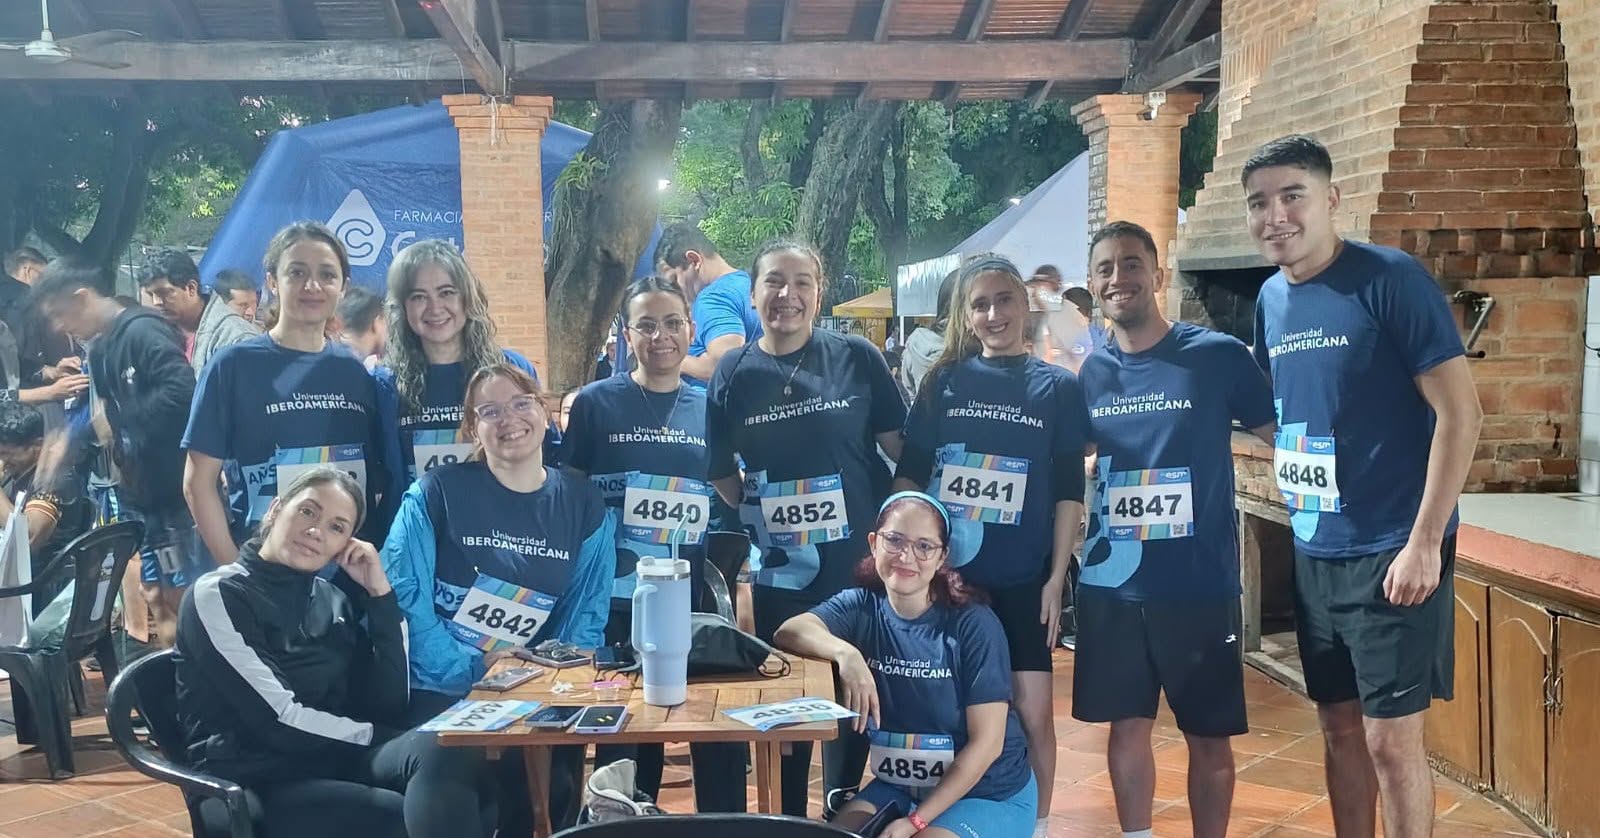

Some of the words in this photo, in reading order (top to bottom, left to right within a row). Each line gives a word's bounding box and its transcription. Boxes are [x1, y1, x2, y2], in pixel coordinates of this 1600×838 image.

[1281, 327, 1323, 343] Universidad
[293, 392, 345, 401] Universidad
[769, 395, 822, 413] Universidad
[1112, 391, 1165, 405] Universidad
[422, 404, 464, 415] Universi
[744, 400, 850, 426] IBEROAMERICANA
[968, 400, 1021, 414] Universidad
[1091, 400, 1192, 418] IBEROAMERICANA
[947, 408, 1044, 429] IBEROAMERICANA
[633, 425, 686, 436] Univerdad
[608, 433, 707, 448] IBEROAMERICANA
[1279, 461, 1328, 488] 4848
[947, 476, 1014, 503] 4841
[632, 498, 701, 524] 4840
[771, 501, 837, 525] 4852
[1115, 494, 1182, 518] 4847
[492, 529, 546, 547] Universidad
[462, 536, 570, 561] IBEROAMERICANA
[468, 603, 537, 637] 4842
[878, 756, 944, 780] 4854
